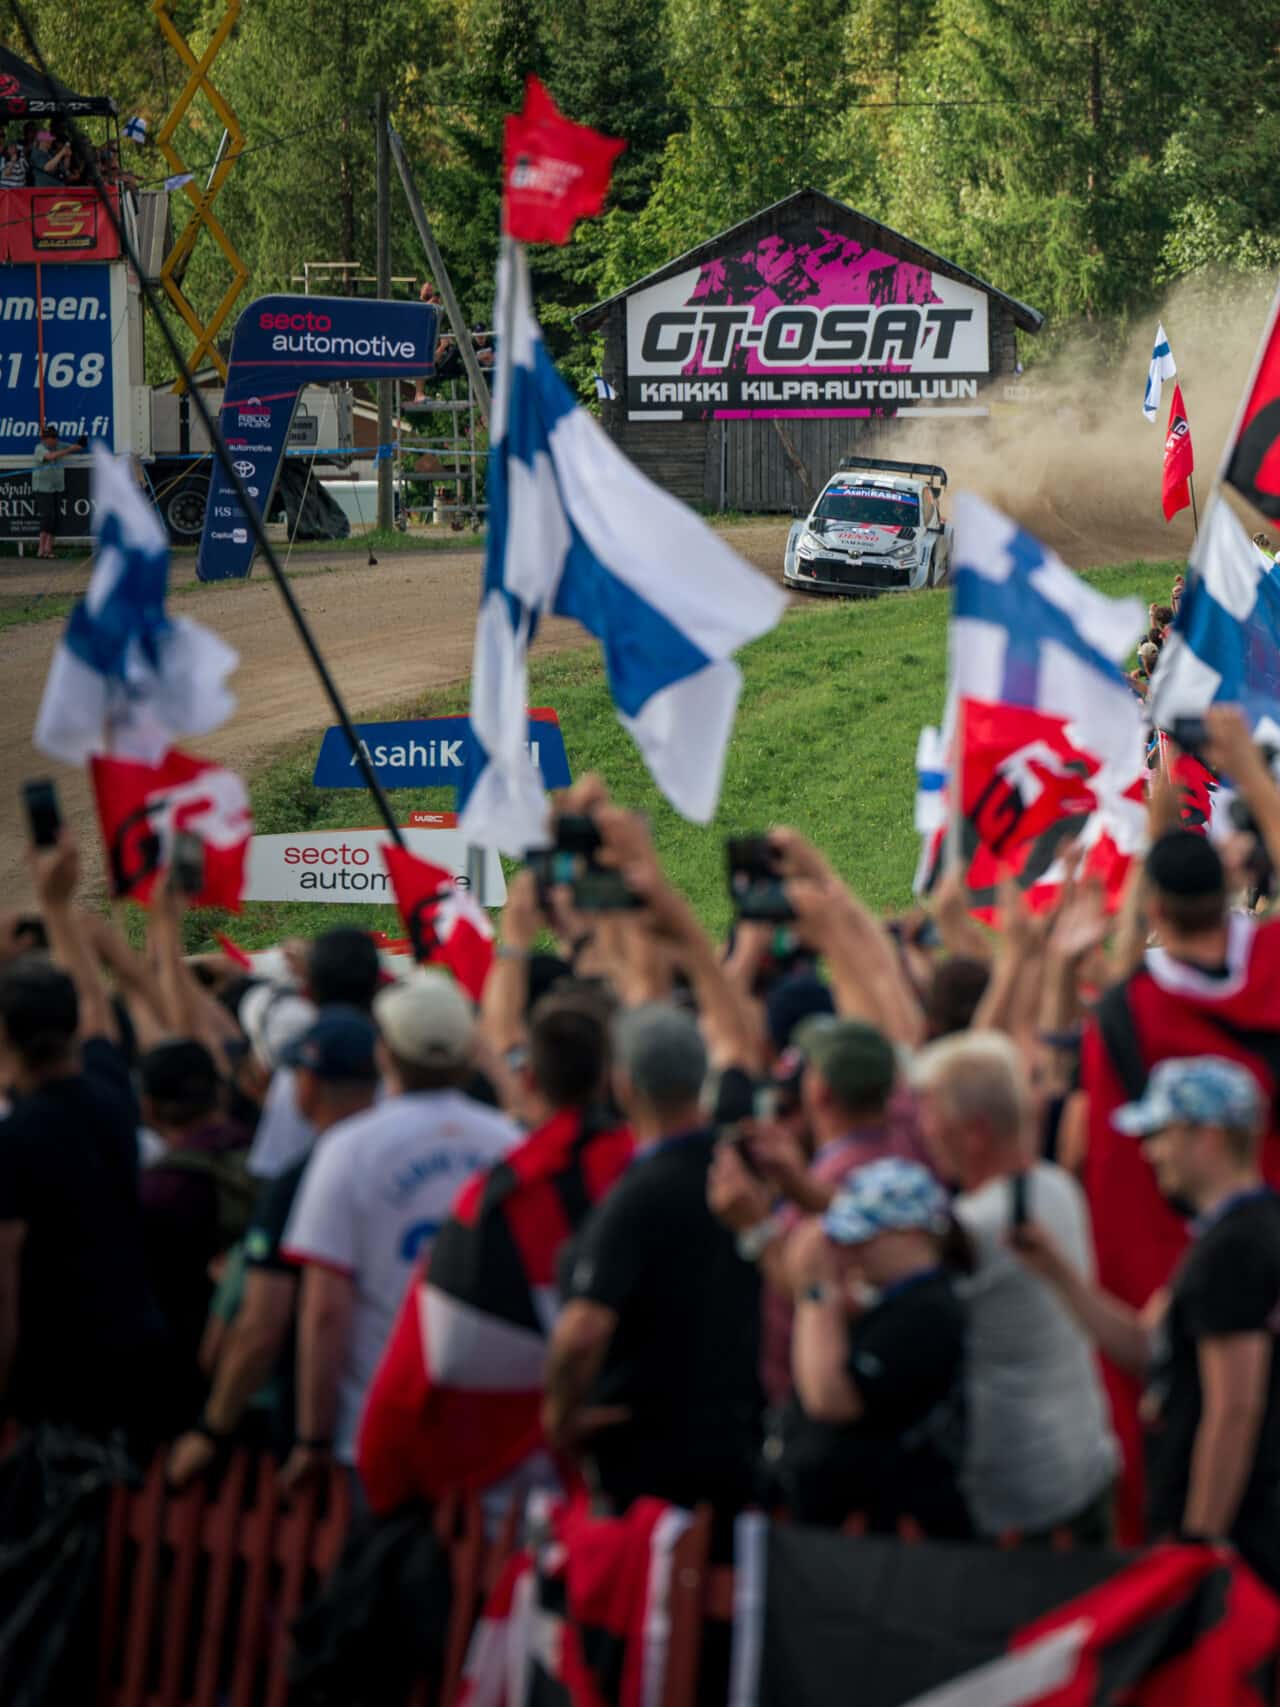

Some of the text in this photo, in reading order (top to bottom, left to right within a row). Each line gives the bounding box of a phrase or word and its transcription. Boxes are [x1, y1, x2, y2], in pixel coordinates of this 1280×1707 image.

[0, 296, 107, 321] meen.
[259, 312, 332, 332] secto
[272, 332, 415, 359] automotive
[641, 308, 973, 364] GT-OSAT
[0, 352, 105, 388] 1 168
[641, 379, 978, 402] KAIKKI KILPA-AUTOILUUN
[349, 740, 540, 768] AsahiKI
[414, 815, 444, 823] WRC
[284, 844, 369, 865] secto
[300, 869, 471, 890] autome
